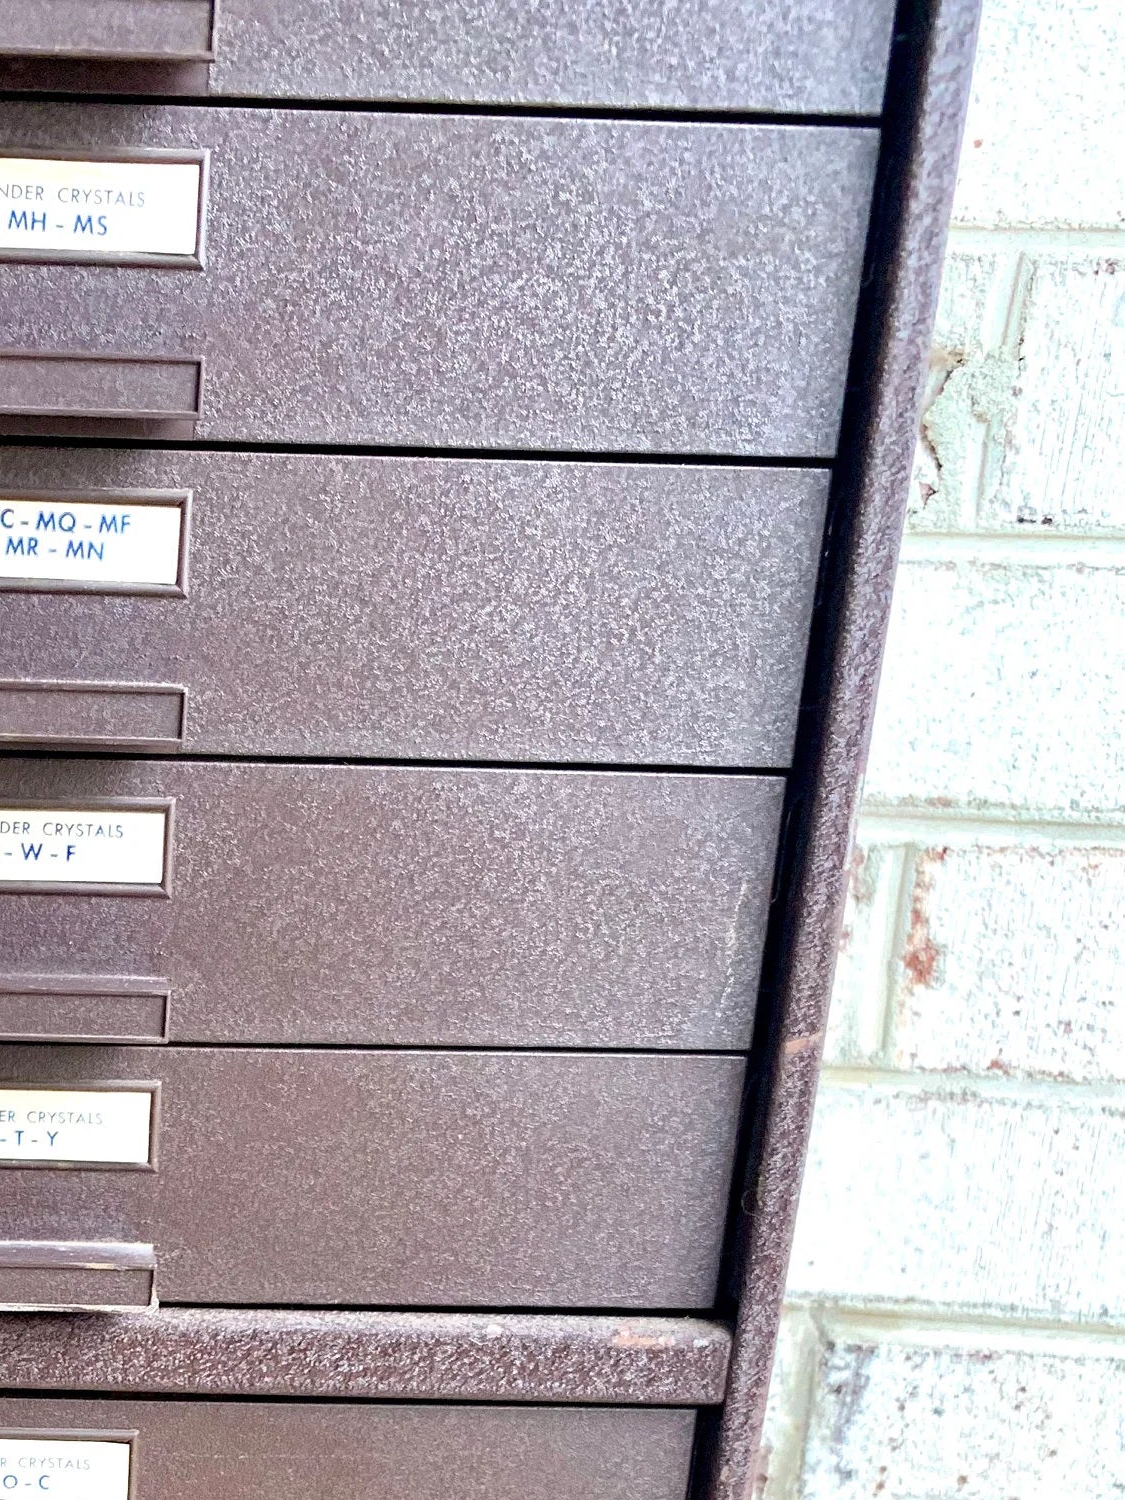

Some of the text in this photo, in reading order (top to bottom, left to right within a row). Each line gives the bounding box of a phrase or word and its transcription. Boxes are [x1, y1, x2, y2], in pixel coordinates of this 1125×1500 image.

[57, 187, 145, 206] CRYSTALS
[41, 822, 124, 838] CRYSTALS
[26, 1110, 104, 1126] CRYSTALS
[18, 1457, 90, 1471] CRYSTALS
